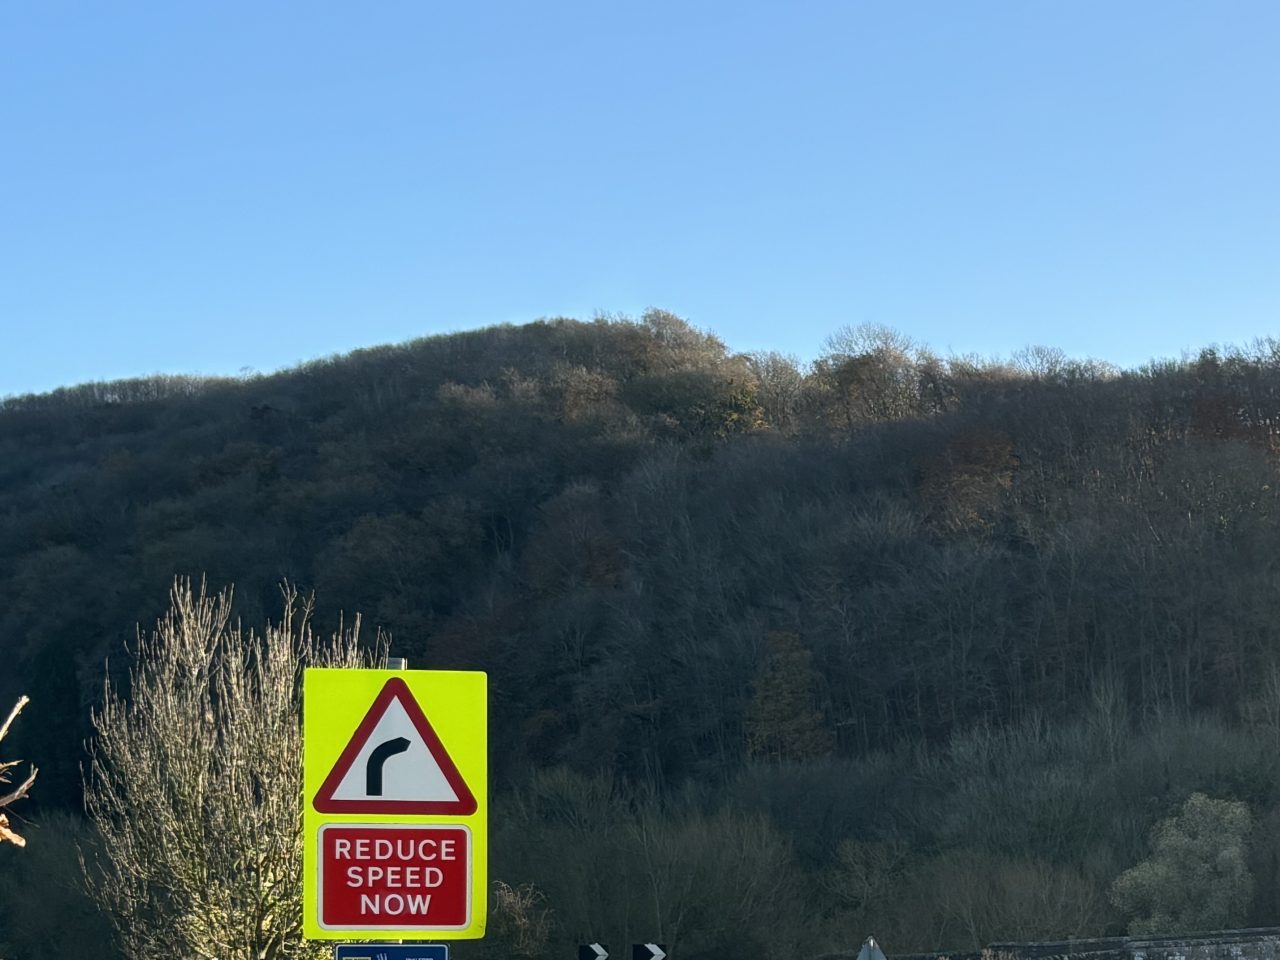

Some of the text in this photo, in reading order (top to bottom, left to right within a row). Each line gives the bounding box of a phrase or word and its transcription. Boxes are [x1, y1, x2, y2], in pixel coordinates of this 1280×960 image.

[335, 839, 456, 860] REDUCE
[347, 866, 444, 888] SPEED
[360, 894, 431, 915] NOW
